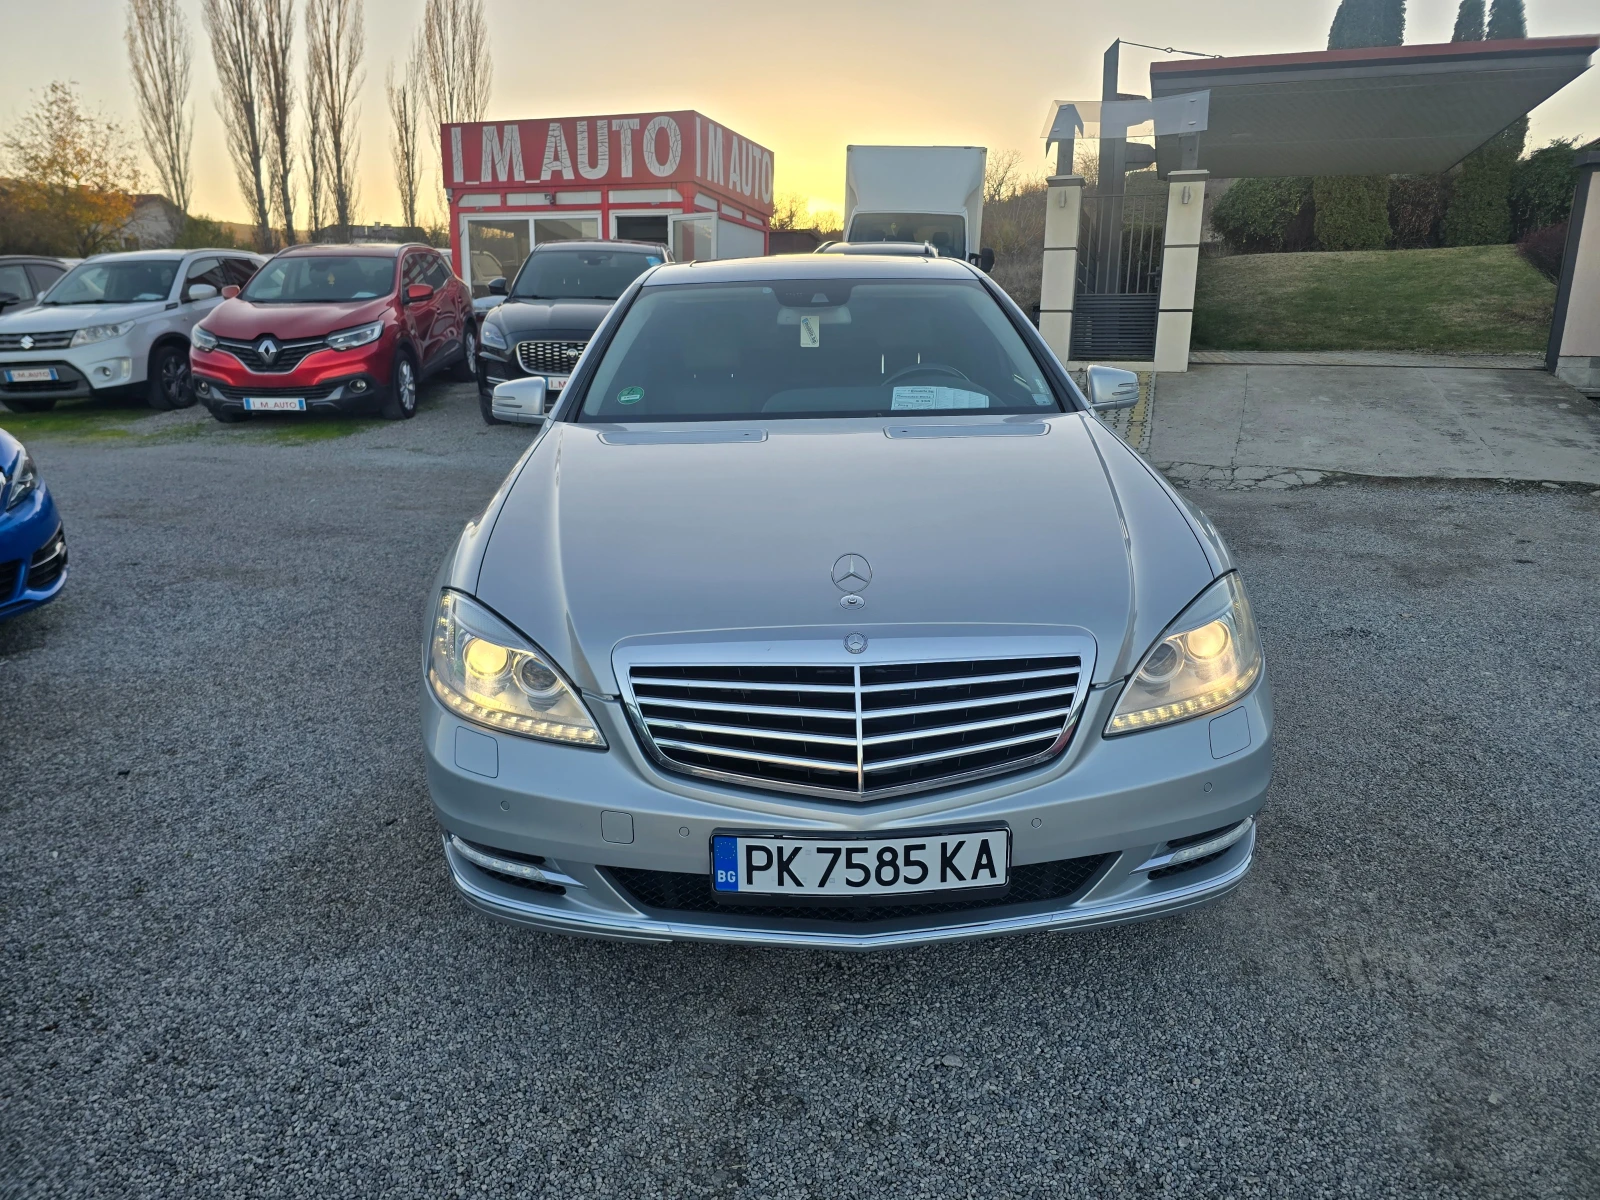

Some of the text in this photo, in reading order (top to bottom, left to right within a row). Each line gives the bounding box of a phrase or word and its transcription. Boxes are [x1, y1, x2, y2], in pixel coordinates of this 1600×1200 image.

[696, 116, 772, 205] I M AUTO
[717, 870, 736, 883] BG
[816, 843, 929, 888] 7585
